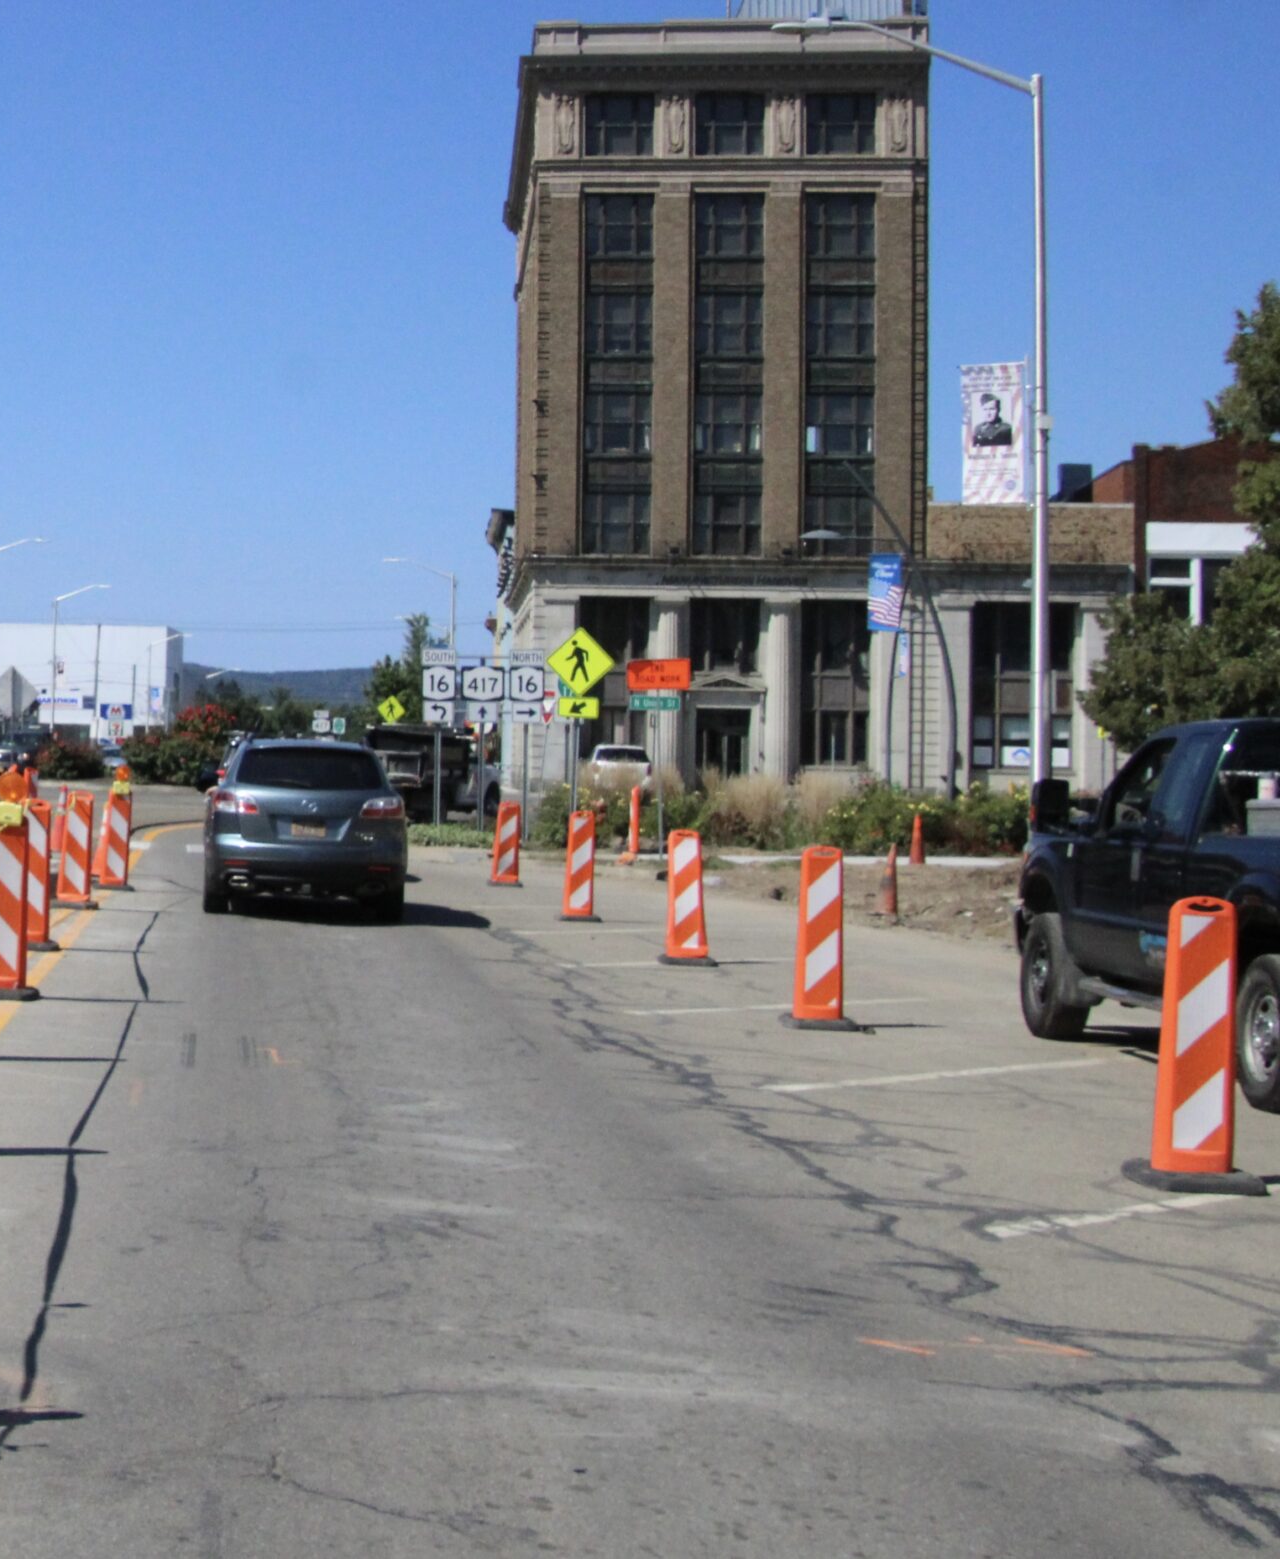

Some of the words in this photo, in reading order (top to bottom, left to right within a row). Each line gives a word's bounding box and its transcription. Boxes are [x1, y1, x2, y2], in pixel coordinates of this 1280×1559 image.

[425, 652, 454, 662] SOUTH
[512, 652, 543, 662] NORTH
[430, 674, 449, 693] 16
[468, 677, 498, 693] 417
[519, 675, 538, 693] 16
